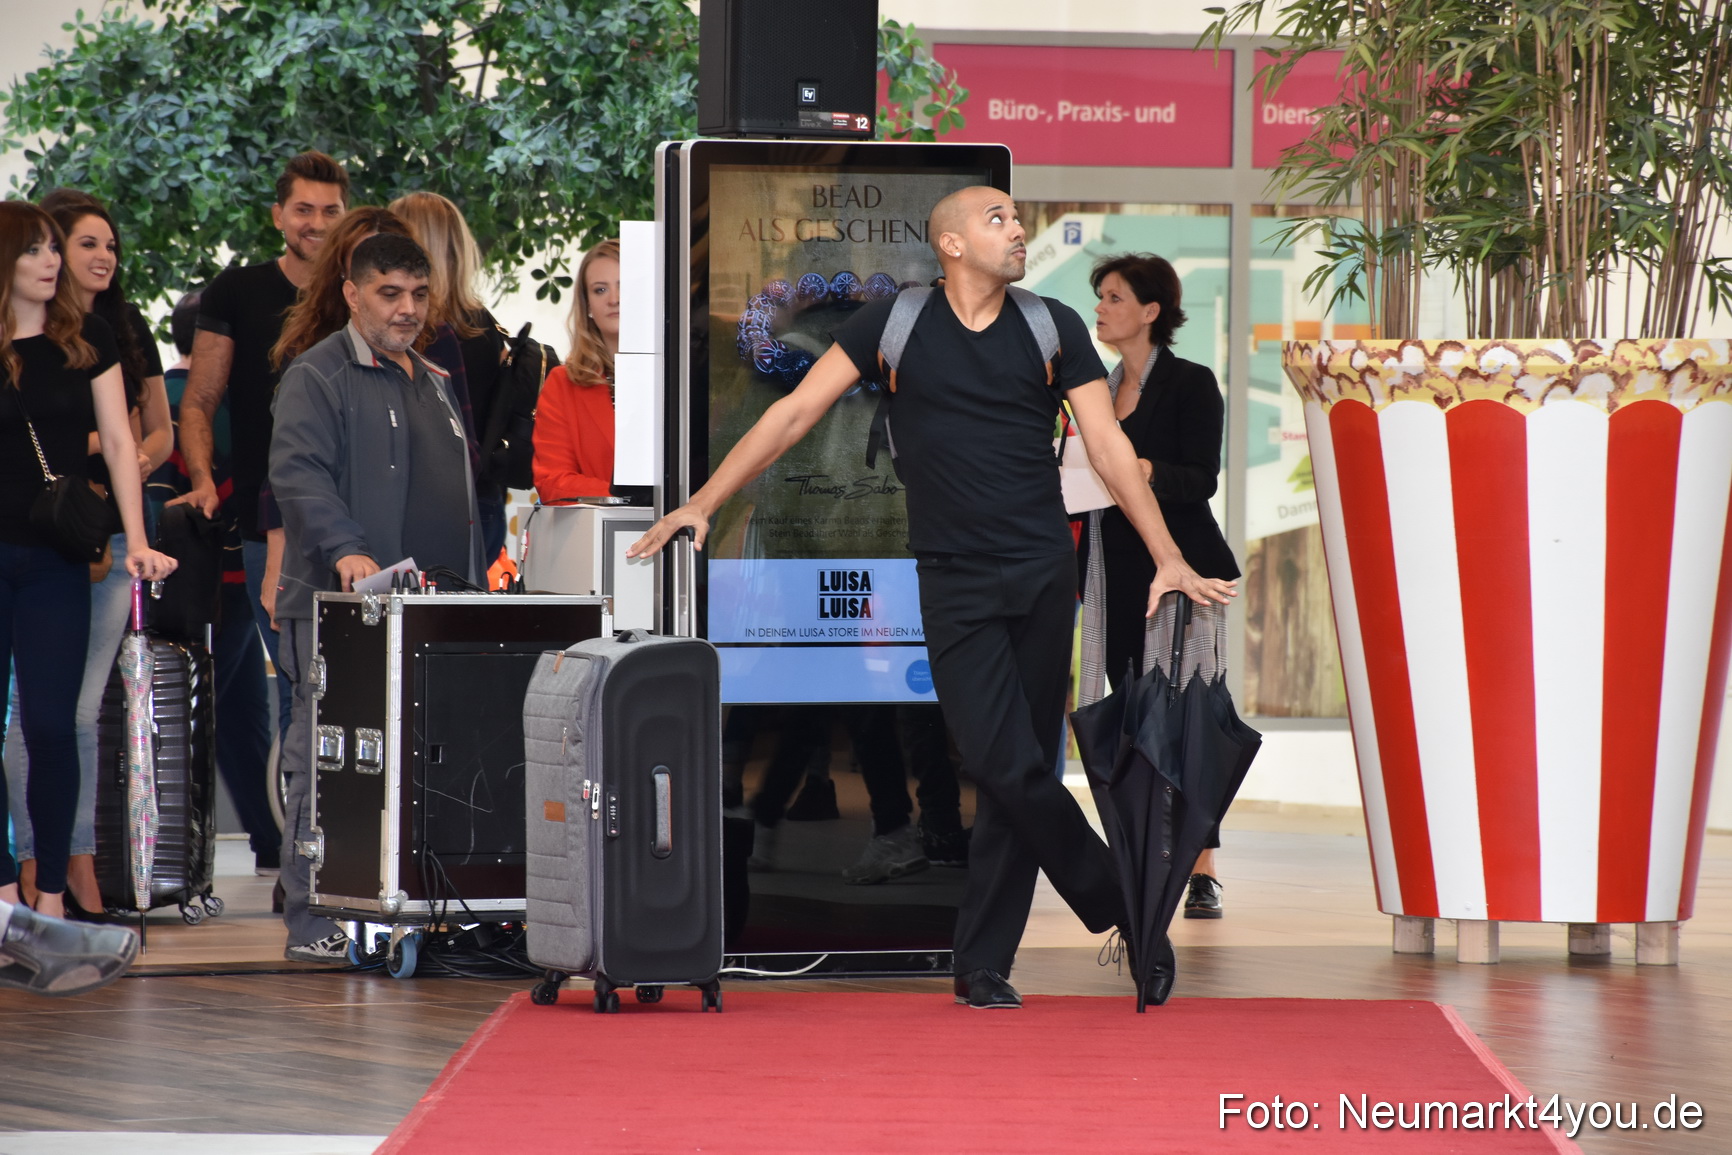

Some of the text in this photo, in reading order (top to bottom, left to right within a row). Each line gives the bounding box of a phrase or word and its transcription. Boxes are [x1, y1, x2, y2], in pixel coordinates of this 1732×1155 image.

[989, 99, 1175, 123] Büro-, Praxis- und
[855, 117, 868, 129] 12
[813, 184, 882, 209] BEAD
[739, 218, 785, 242] ALS
[785, 475, 905, 499] Thomas Sabo
[768, 515, 788, 525] Kauf
[789, 515, 812, 525] eines
[814, 515, 841, 525] Karma
[769, 528, 790, 538] Stein
[793, 528, 813, 538] Bead
[819, 571, 871, 592] LUISA
[819, 597, 871, 618] LUISA
[745, 627, 756, 637] IN
[758, 627, 797, 638] DEINEM
[799, 627, 826, 637] LUISA
[828, 627, 859, 637] STORE
[861, 627, 873, 637] IM
[876, 627, 909, 637] NEUEN
